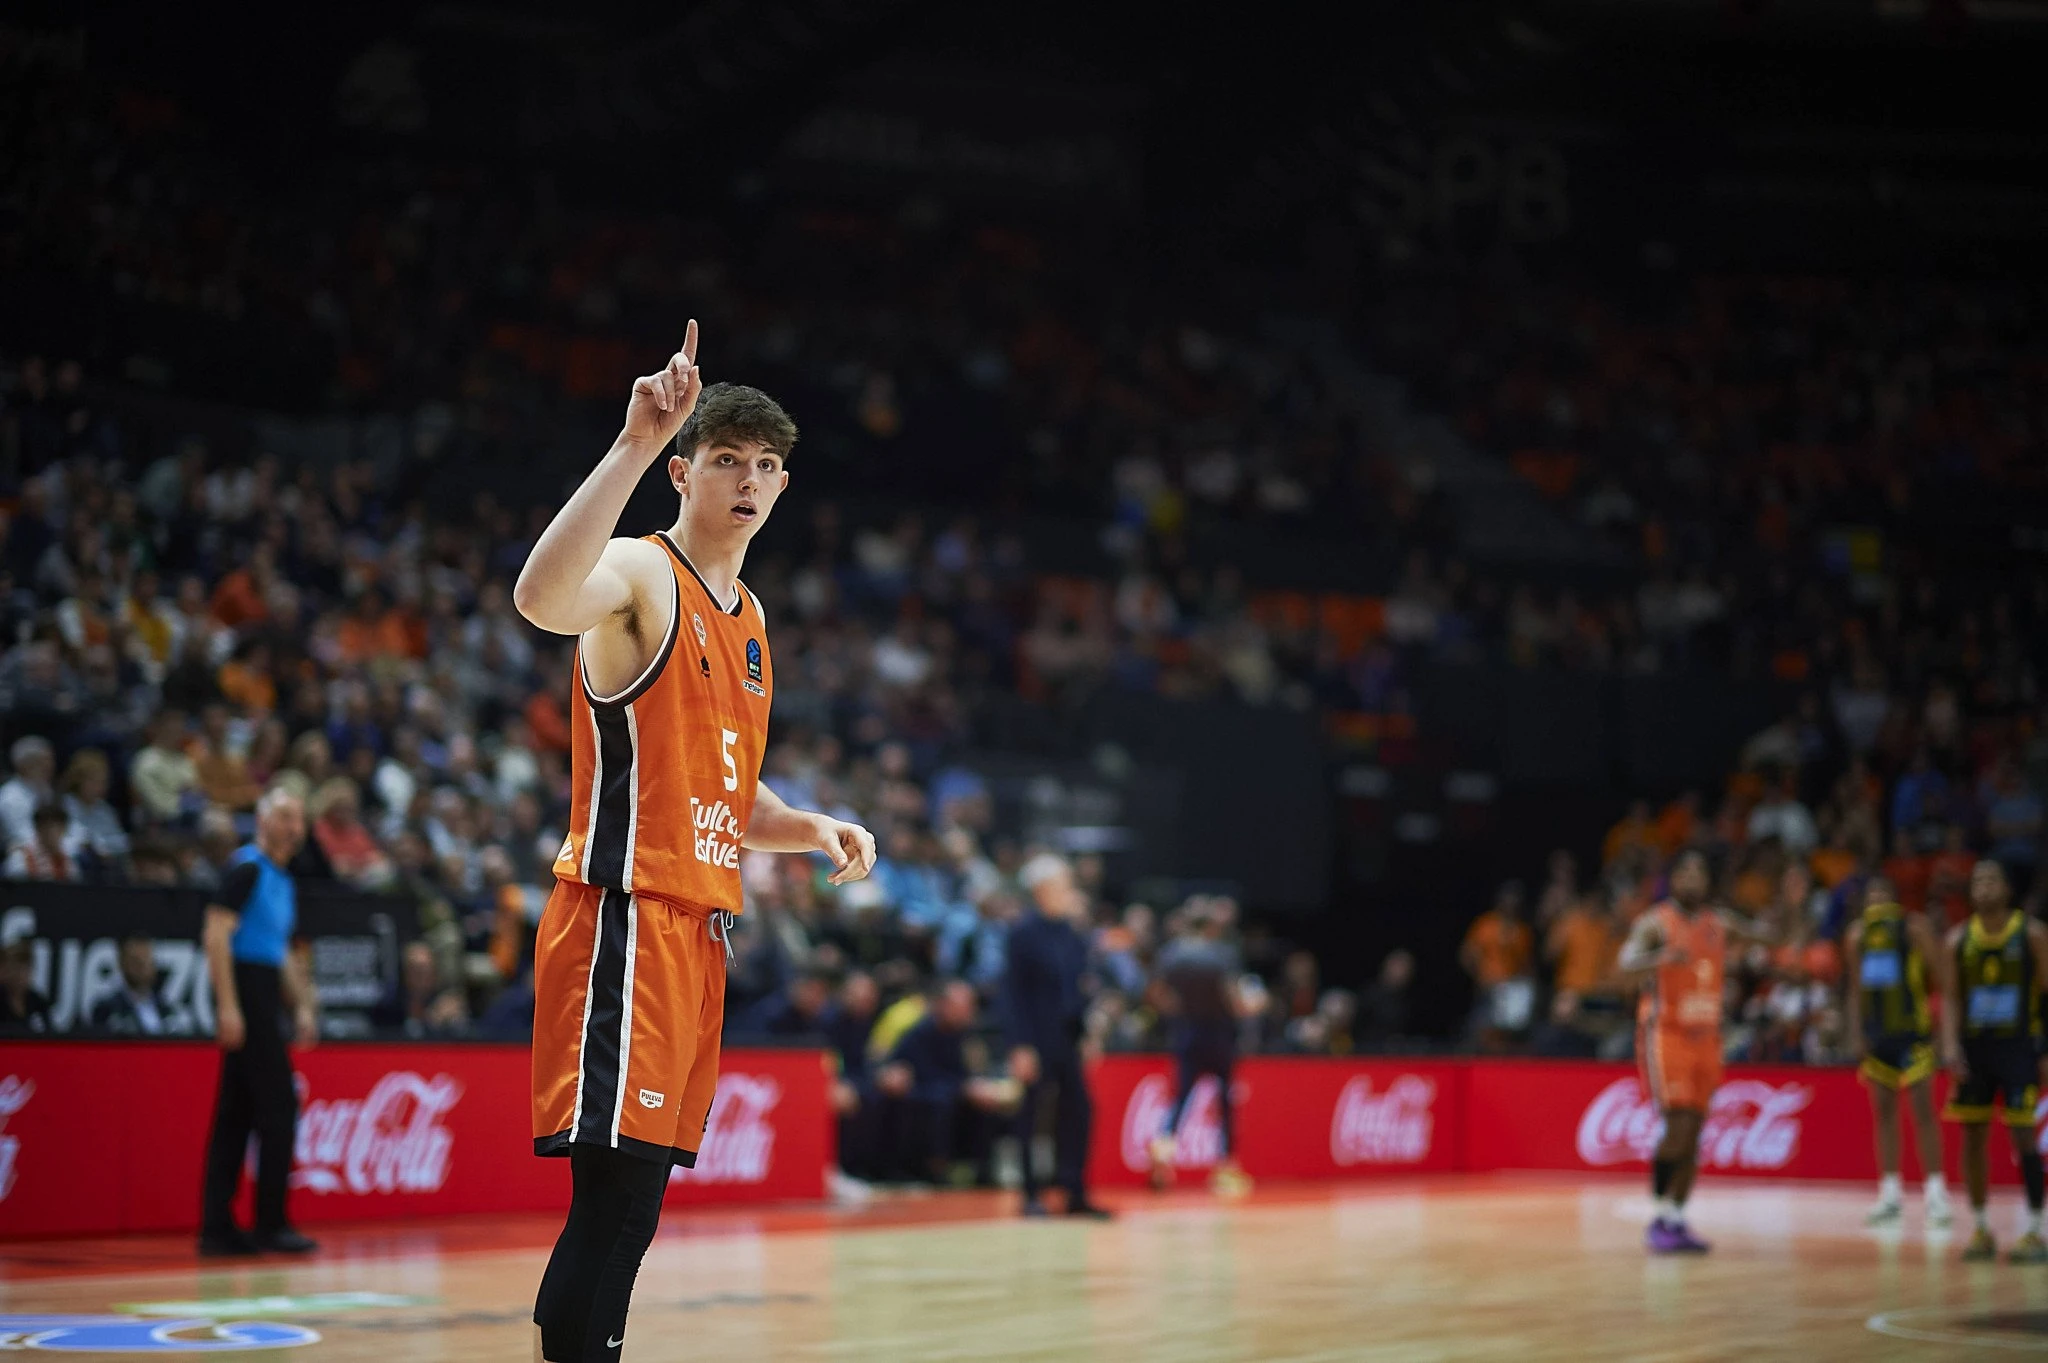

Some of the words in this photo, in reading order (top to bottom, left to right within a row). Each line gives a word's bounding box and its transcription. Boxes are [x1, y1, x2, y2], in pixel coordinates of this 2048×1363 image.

[722, 728, 738, 792] 5
[694, 829, 740, 870] Esfue
[641, 1091, 662, 1103] PULEVA
